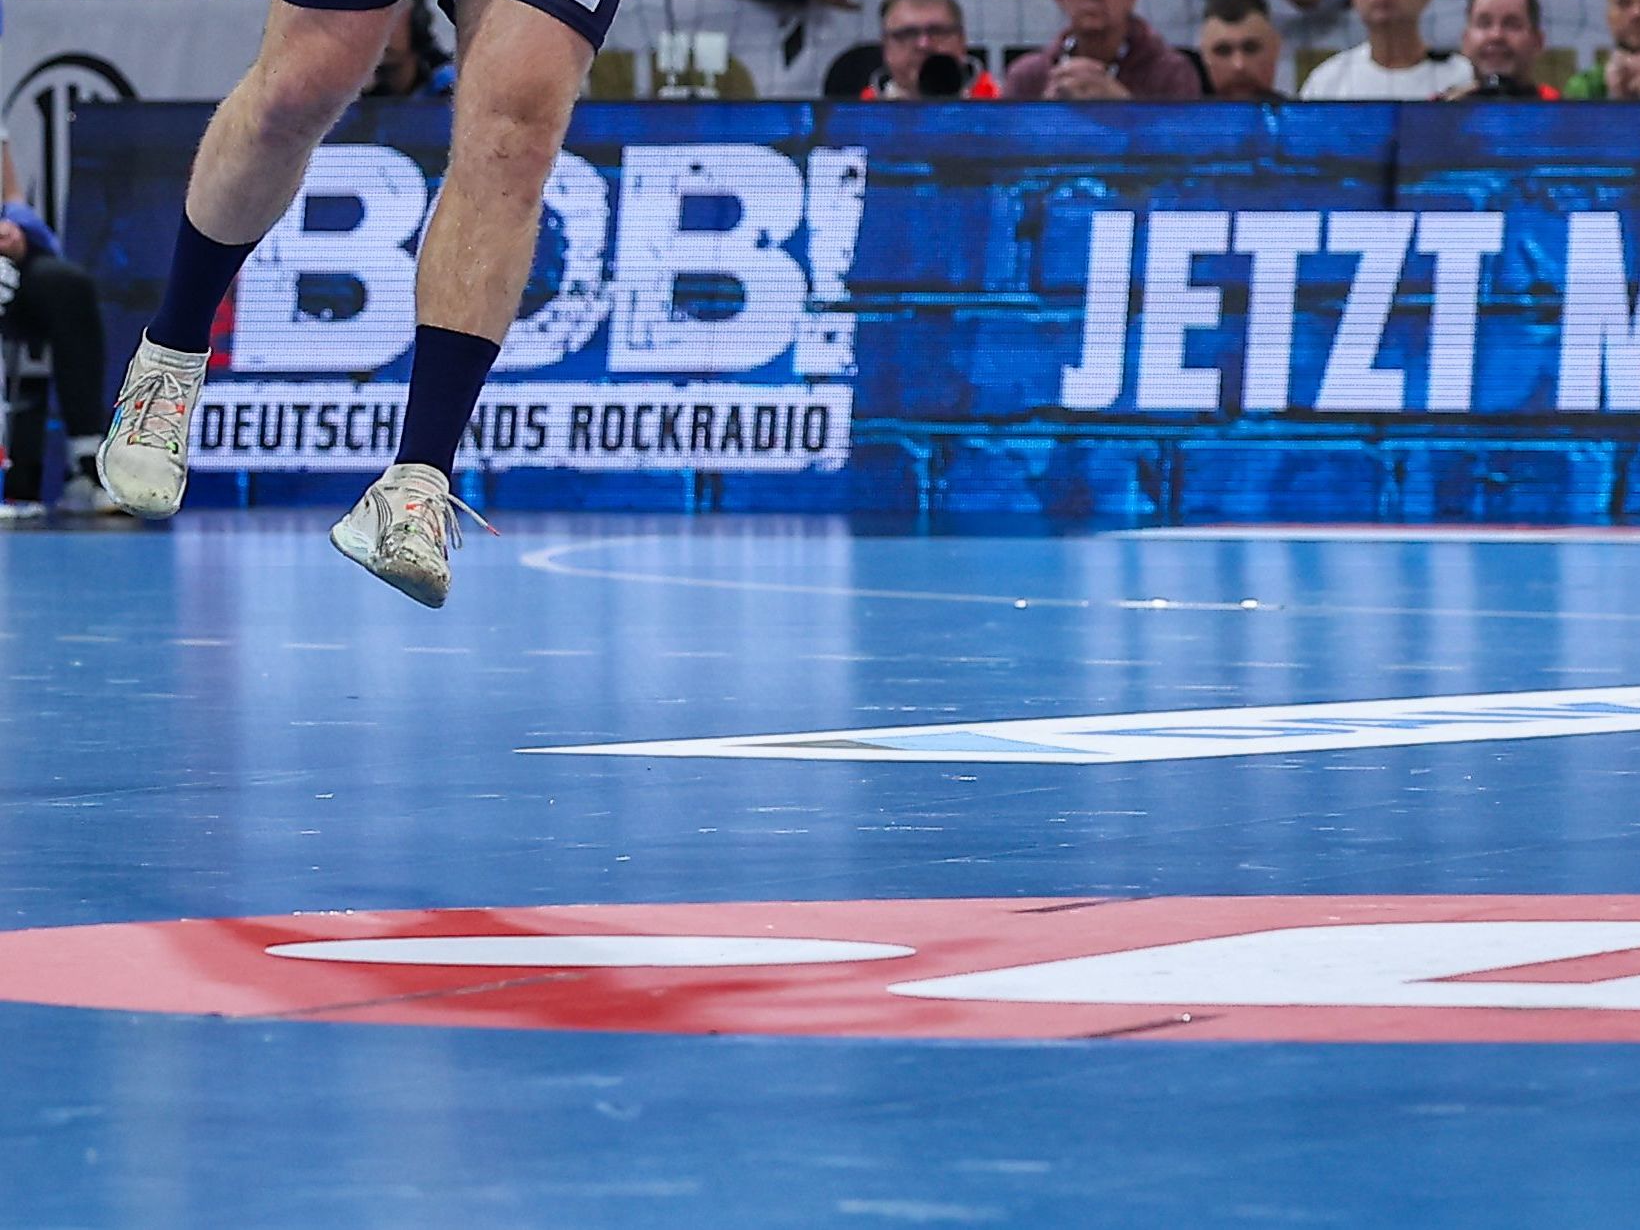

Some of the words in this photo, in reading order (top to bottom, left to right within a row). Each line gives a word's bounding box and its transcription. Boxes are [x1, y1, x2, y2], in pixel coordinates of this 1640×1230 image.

[1060, 210, 1504, 412] JETZT
[201, 404, 547, 453] DEUTSCHNDS
[568, 404, 829, 453] ROCKRADIO
